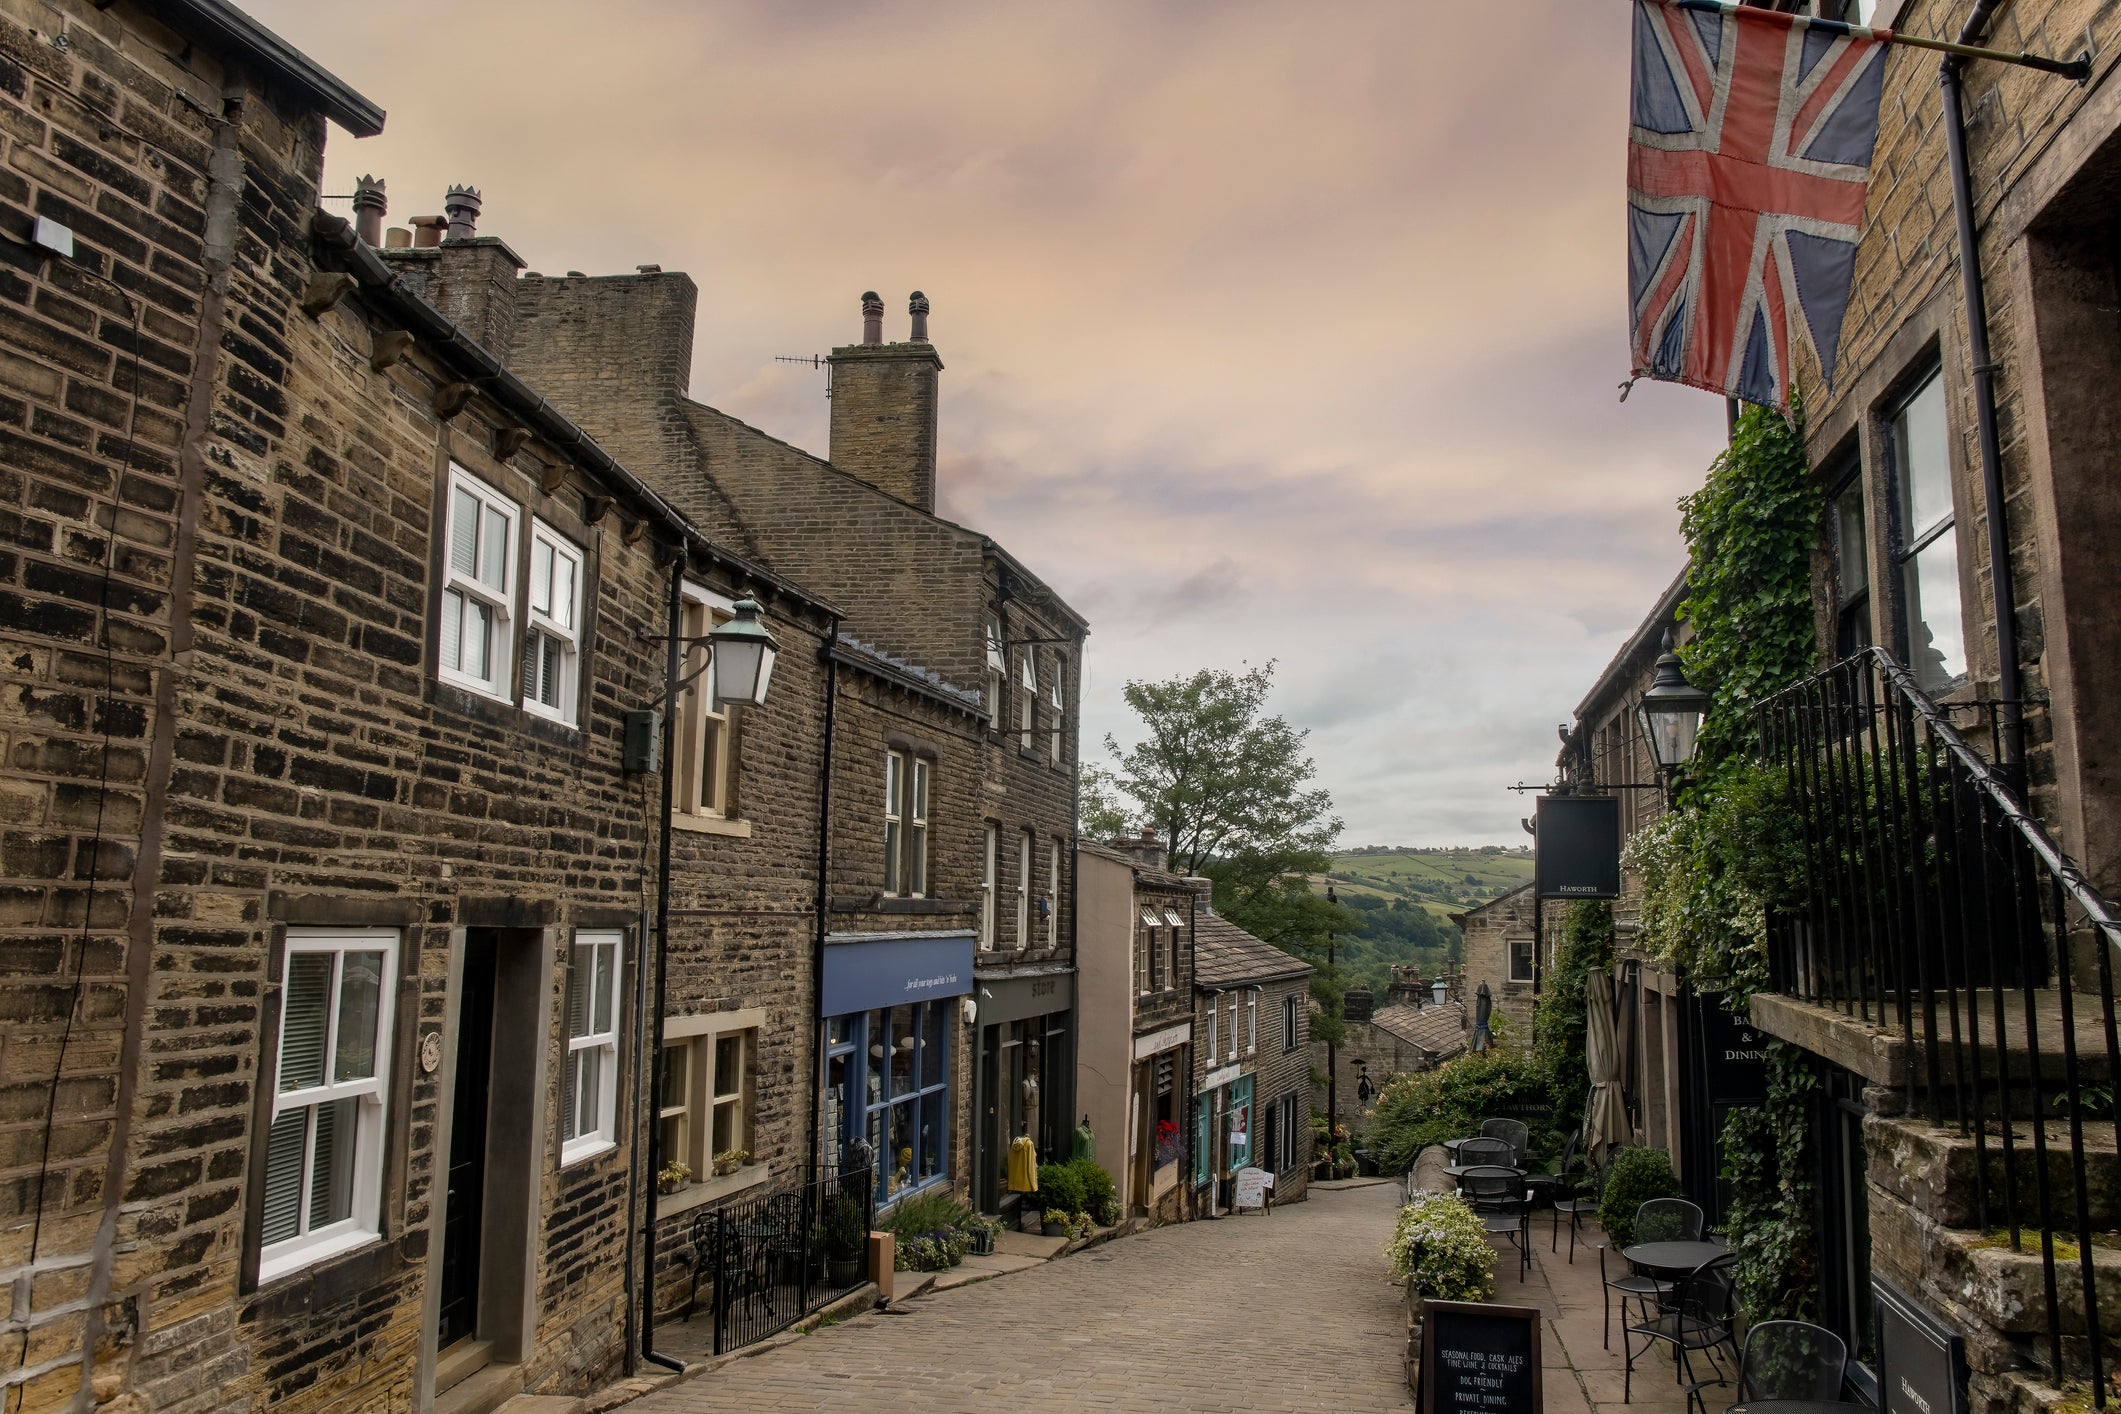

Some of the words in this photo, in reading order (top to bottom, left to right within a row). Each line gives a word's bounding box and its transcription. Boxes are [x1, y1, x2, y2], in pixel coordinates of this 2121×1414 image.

[1733, 1016, 1750, 1025] BA
[1741, 1032, 1752, 1043] &
[1441, 1350, 1469, 1360] SEASONAL
[1488, 1354, 1505, 1363] CASK
[1508, 1355, 1523, 1365] ALES
[1447, 1359, 1461, 1368] FINE
[1463, 1360, 1478, 1369] WINE
[1488, 1362, 1518, 1372] COCKTAILS
[1473, 1377, 1503, 1388] FRIENDLY
[1455, 1392, 1480, 1403] PRIVATE
